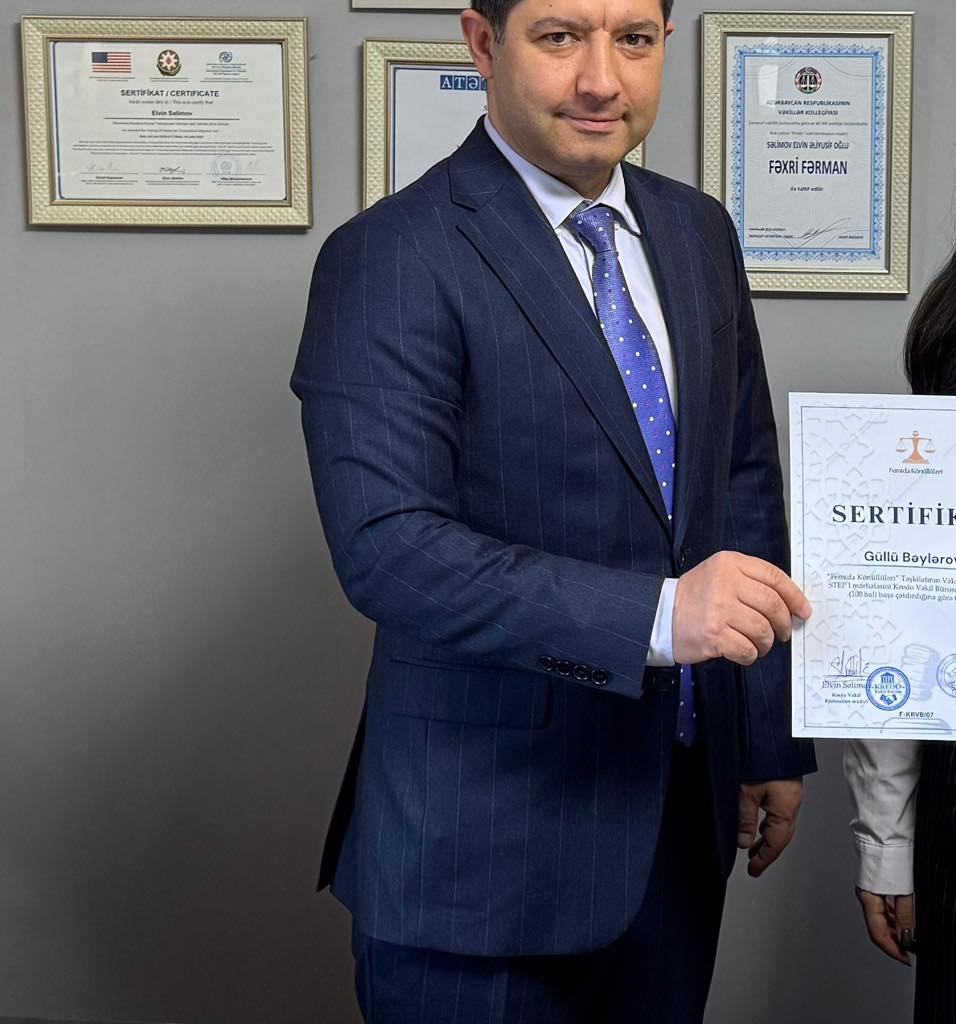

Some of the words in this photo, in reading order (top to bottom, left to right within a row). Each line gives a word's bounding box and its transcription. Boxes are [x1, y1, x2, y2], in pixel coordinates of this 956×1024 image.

[441, 76, 487, 89] ATƏ
[120, 88, 164, 96] SERTİFİKAT
[768, 157, 799, 174] FƏXRİ
[801, 160, 848, 175] FƏRMAN
[864, 550, 899, 562] Güllü
